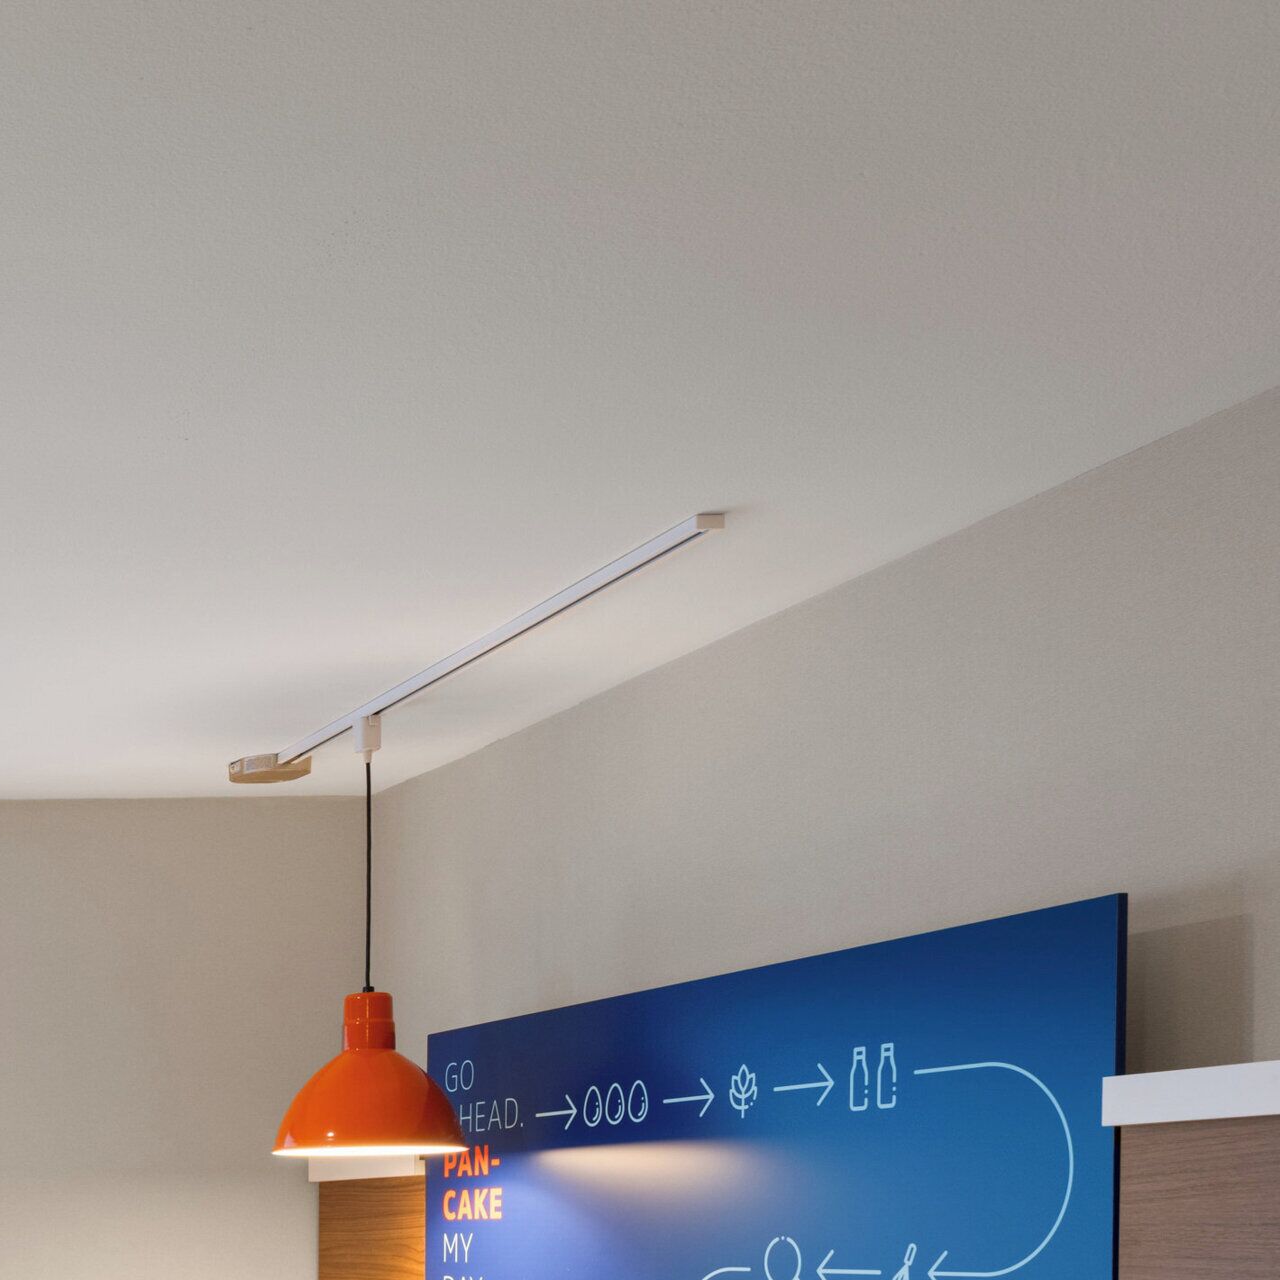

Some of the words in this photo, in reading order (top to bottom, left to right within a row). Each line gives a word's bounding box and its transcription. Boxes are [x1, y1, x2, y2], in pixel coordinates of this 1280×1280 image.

[445, 1059, 475, 1093] GO
[459, 1097, 524, 1133] HEAD.
[443, 1144, 500, 1178] PAN-
[442, 1187, 503, 1221] CAKE
[443, 1232, 474, 1264] MY
